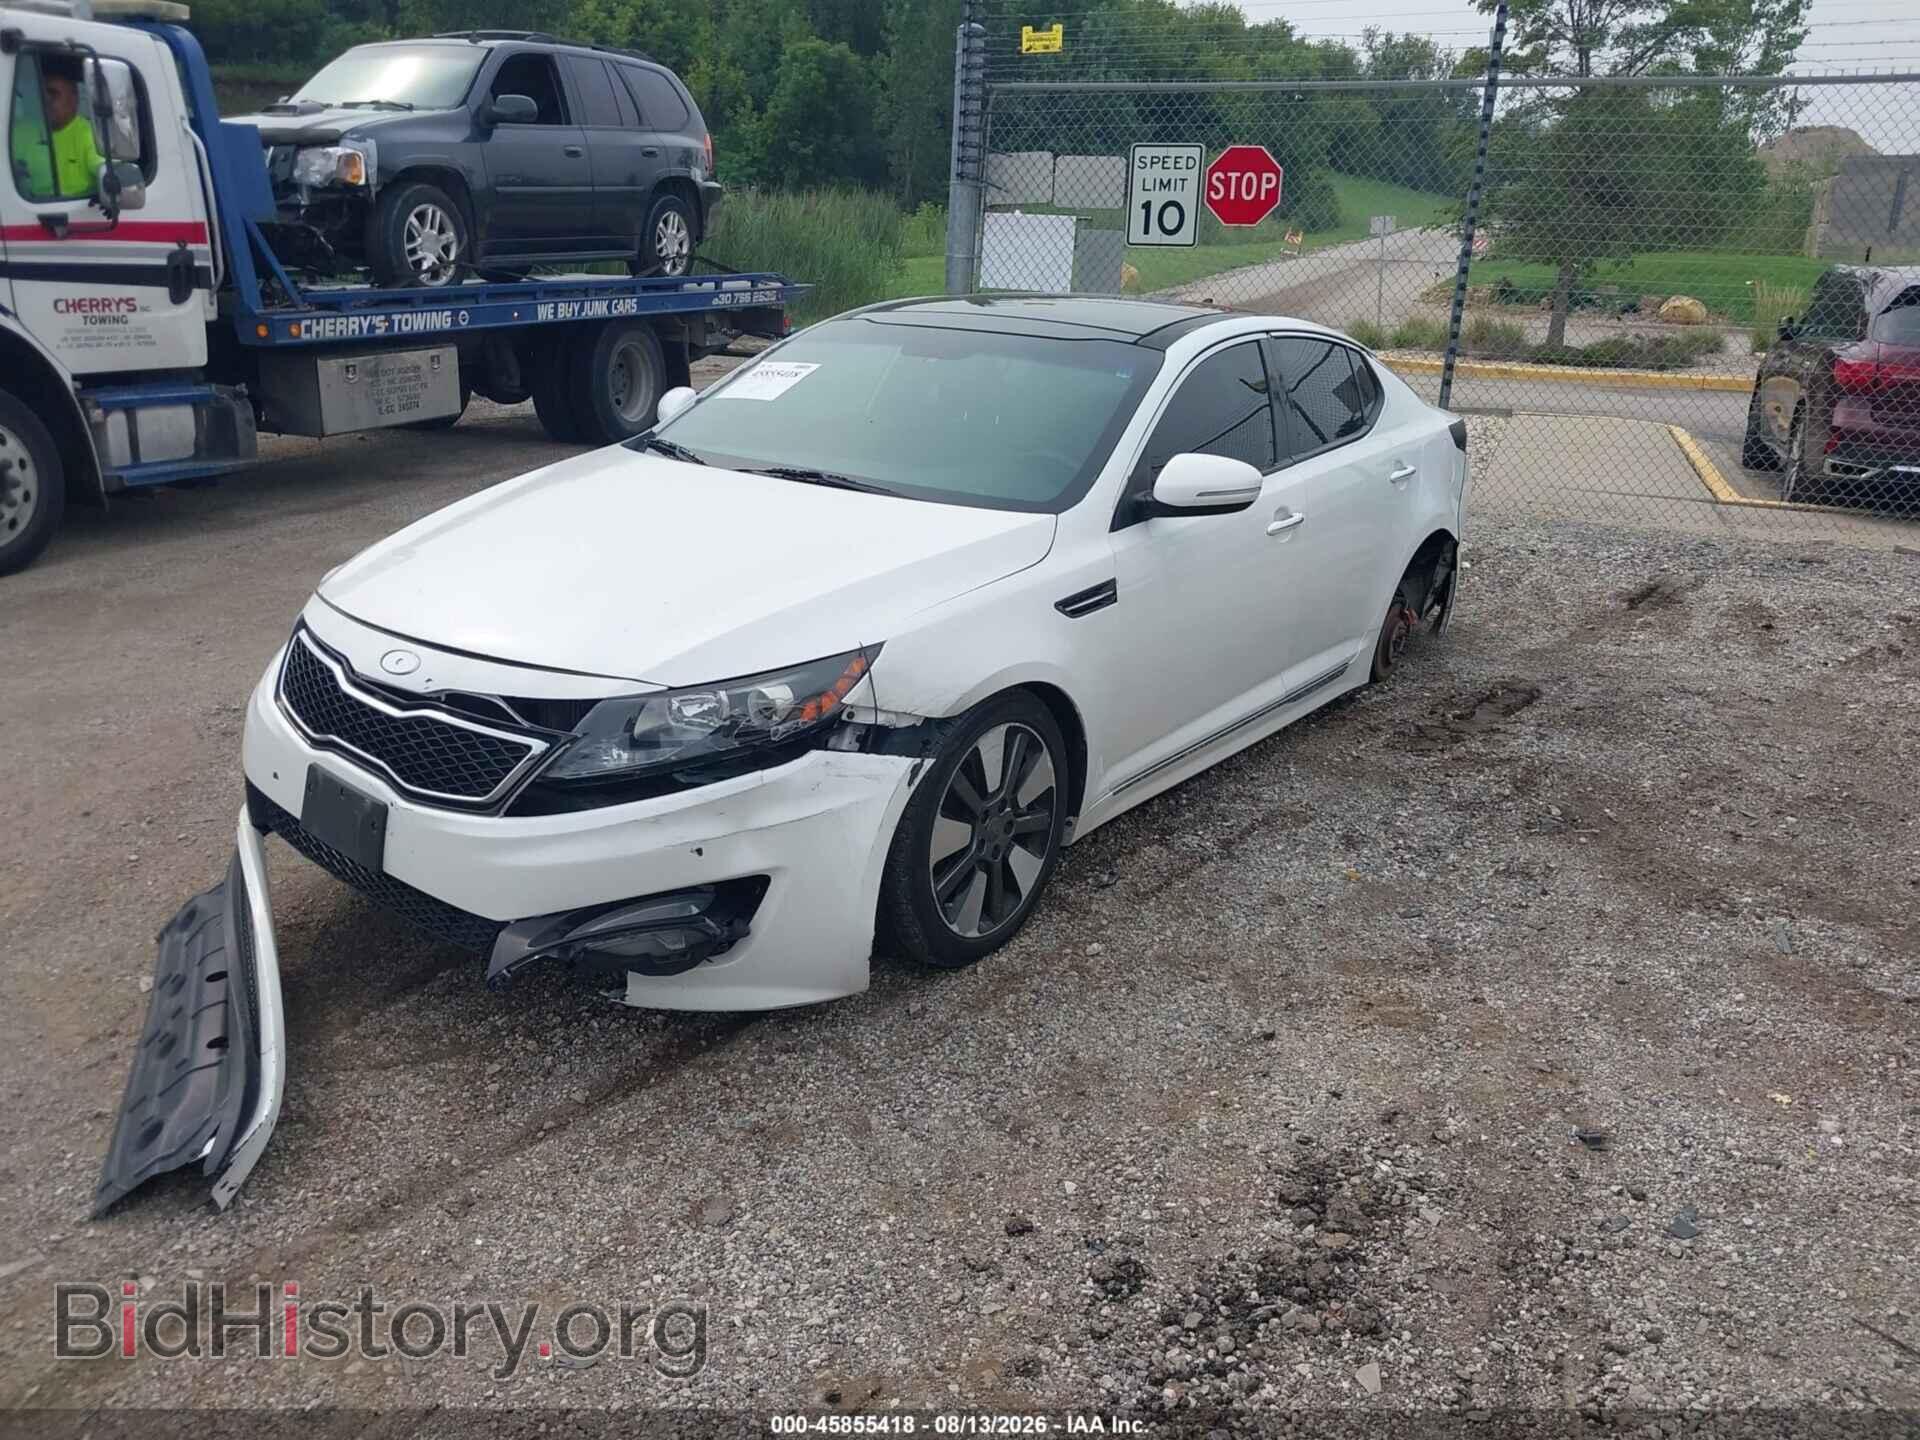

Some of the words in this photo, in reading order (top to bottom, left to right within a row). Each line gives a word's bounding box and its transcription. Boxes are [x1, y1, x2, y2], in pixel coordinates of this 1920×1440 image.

[1137, 155, 1197, 170] SPEED
[1142, 178, 1188, 192] LIMIT
[1209, 171, 1277, 201] STOP
[1141, 199, 1185, 236] 10
[53, 297, 137, 314] CHERRY'S
[537, 303, 555, 320] WE
[557, 301, 581, 318] BUY
[581, 298, 609, 316] JUNK
[611, 298, 638, 314] CARS
[82, 315, 128, 325] TOWING
[301, 315, 386, 339] CHERRY'S
[391, 310, 452, 332] TOWING
